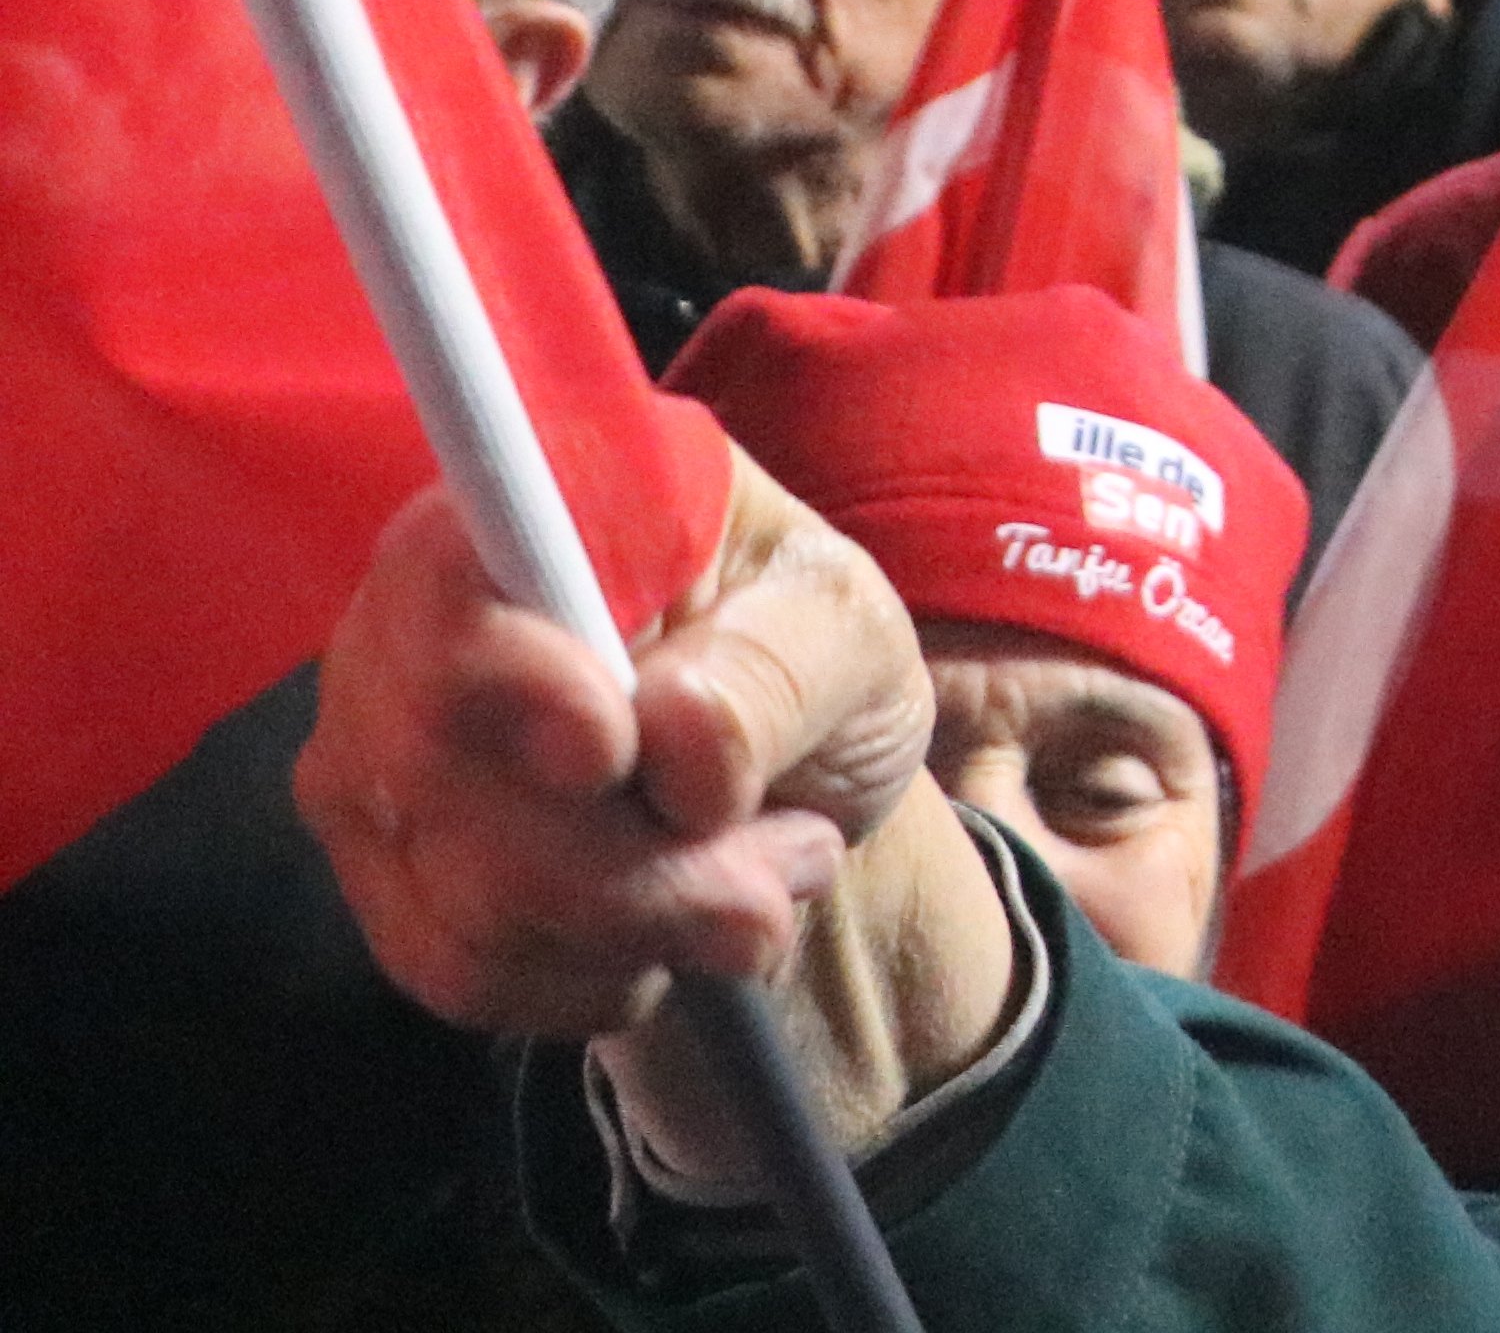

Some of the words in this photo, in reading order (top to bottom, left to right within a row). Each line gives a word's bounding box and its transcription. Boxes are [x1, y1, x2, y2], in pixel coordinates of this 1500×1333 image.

[1071, 418, 1145, 470] ille
[1157, 455, 1207, 507] de
[1088, 470, 1199, 550] Sen
[995, 521, 1135, 600] Tanju
